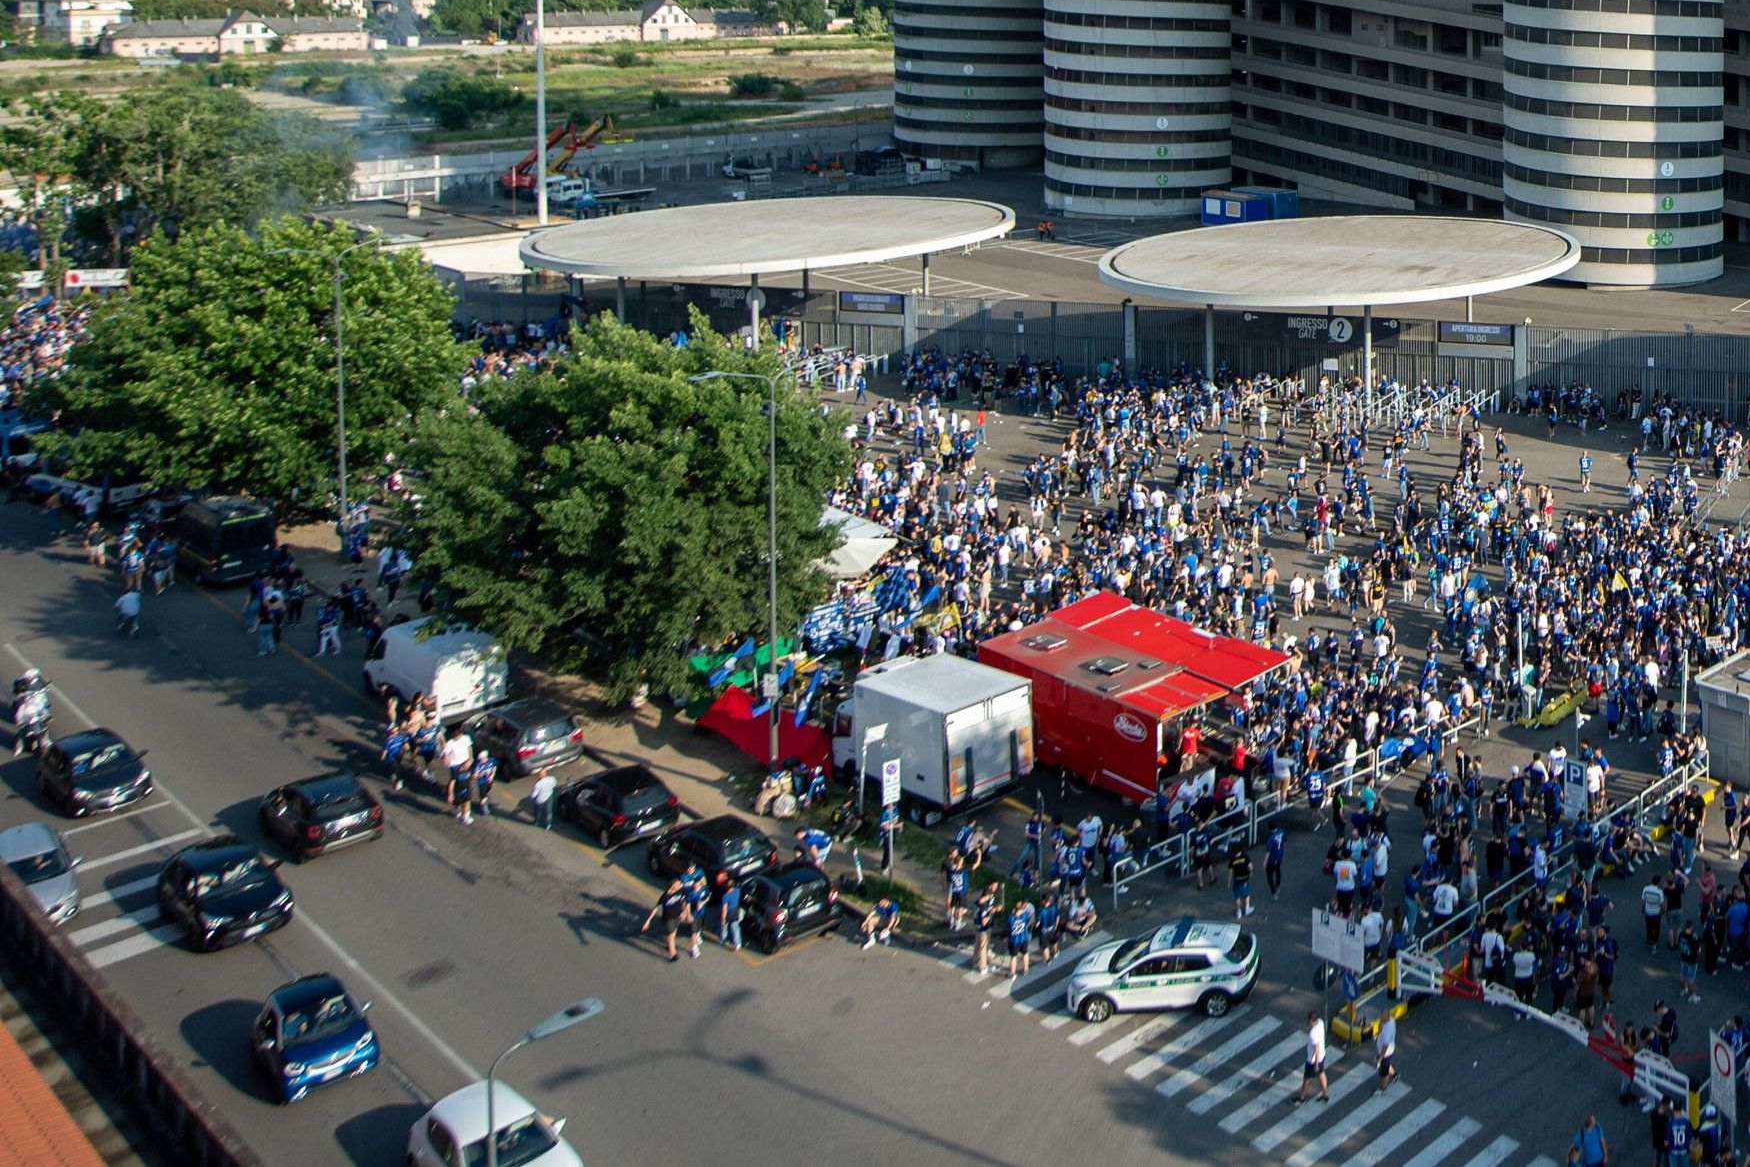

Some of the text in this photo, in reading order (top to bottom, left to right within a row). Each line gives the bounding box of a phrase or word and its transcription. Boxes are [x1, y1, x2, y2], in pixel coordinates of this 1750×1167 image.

[1287, 316, 1345, 340] INGRESSO 2
[1298, 328, 1317, 340] GATE
[1451, 324, 1500, 334] APERTURA INGRESSI
[1465, 334, 1487, 343] 19:00
[1569, 764, 1581, 783] P
[1673, 1130, 1686, 1146] 10
